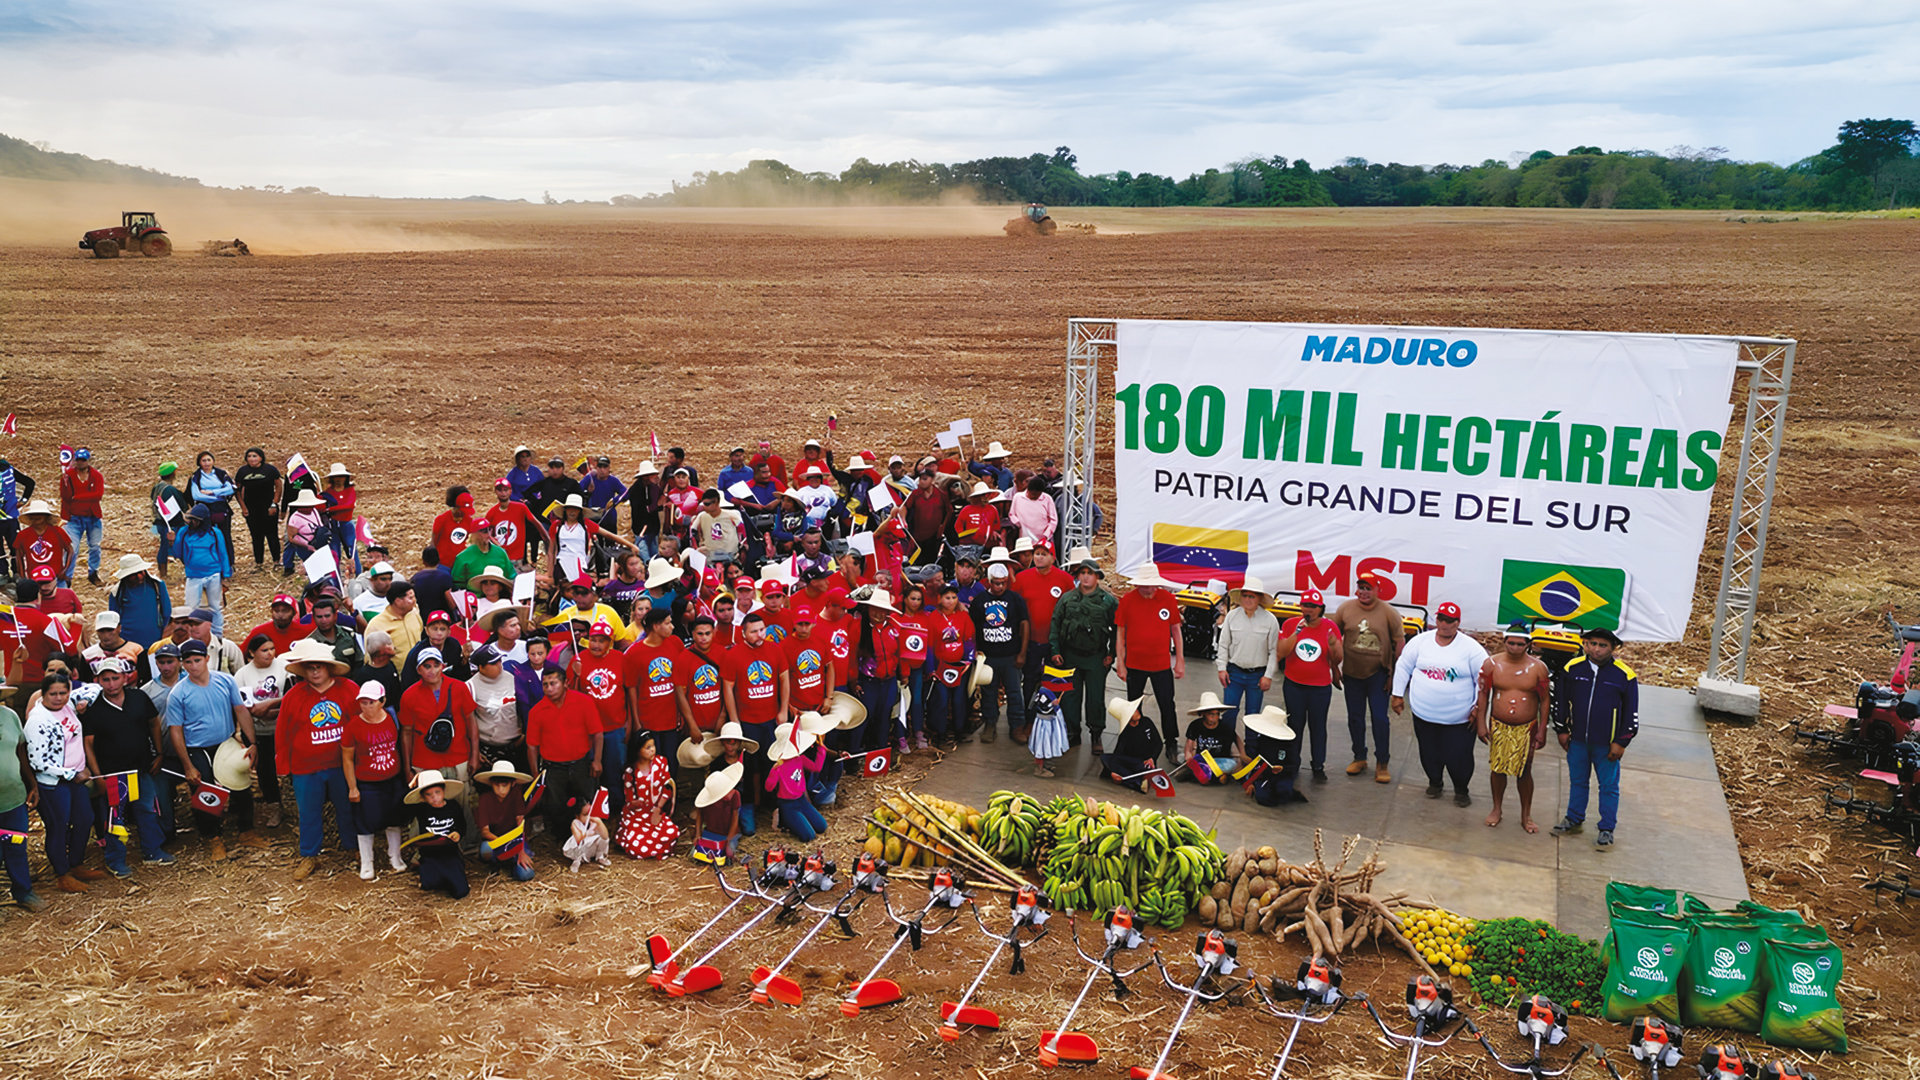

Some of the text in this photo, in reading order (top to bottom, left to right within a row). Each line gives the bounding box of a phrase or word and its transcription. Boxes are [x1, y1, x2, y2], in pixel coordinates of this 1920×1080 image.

[1301, 335, 1478, 368] MADURO
[1115, 383, 1723, 492] 180 MIL HECTÁREAS
[1154, 469, 1631, 534] PATRIA GRANDE DEL SUR
[1294, 549, 1446, 607] MST
